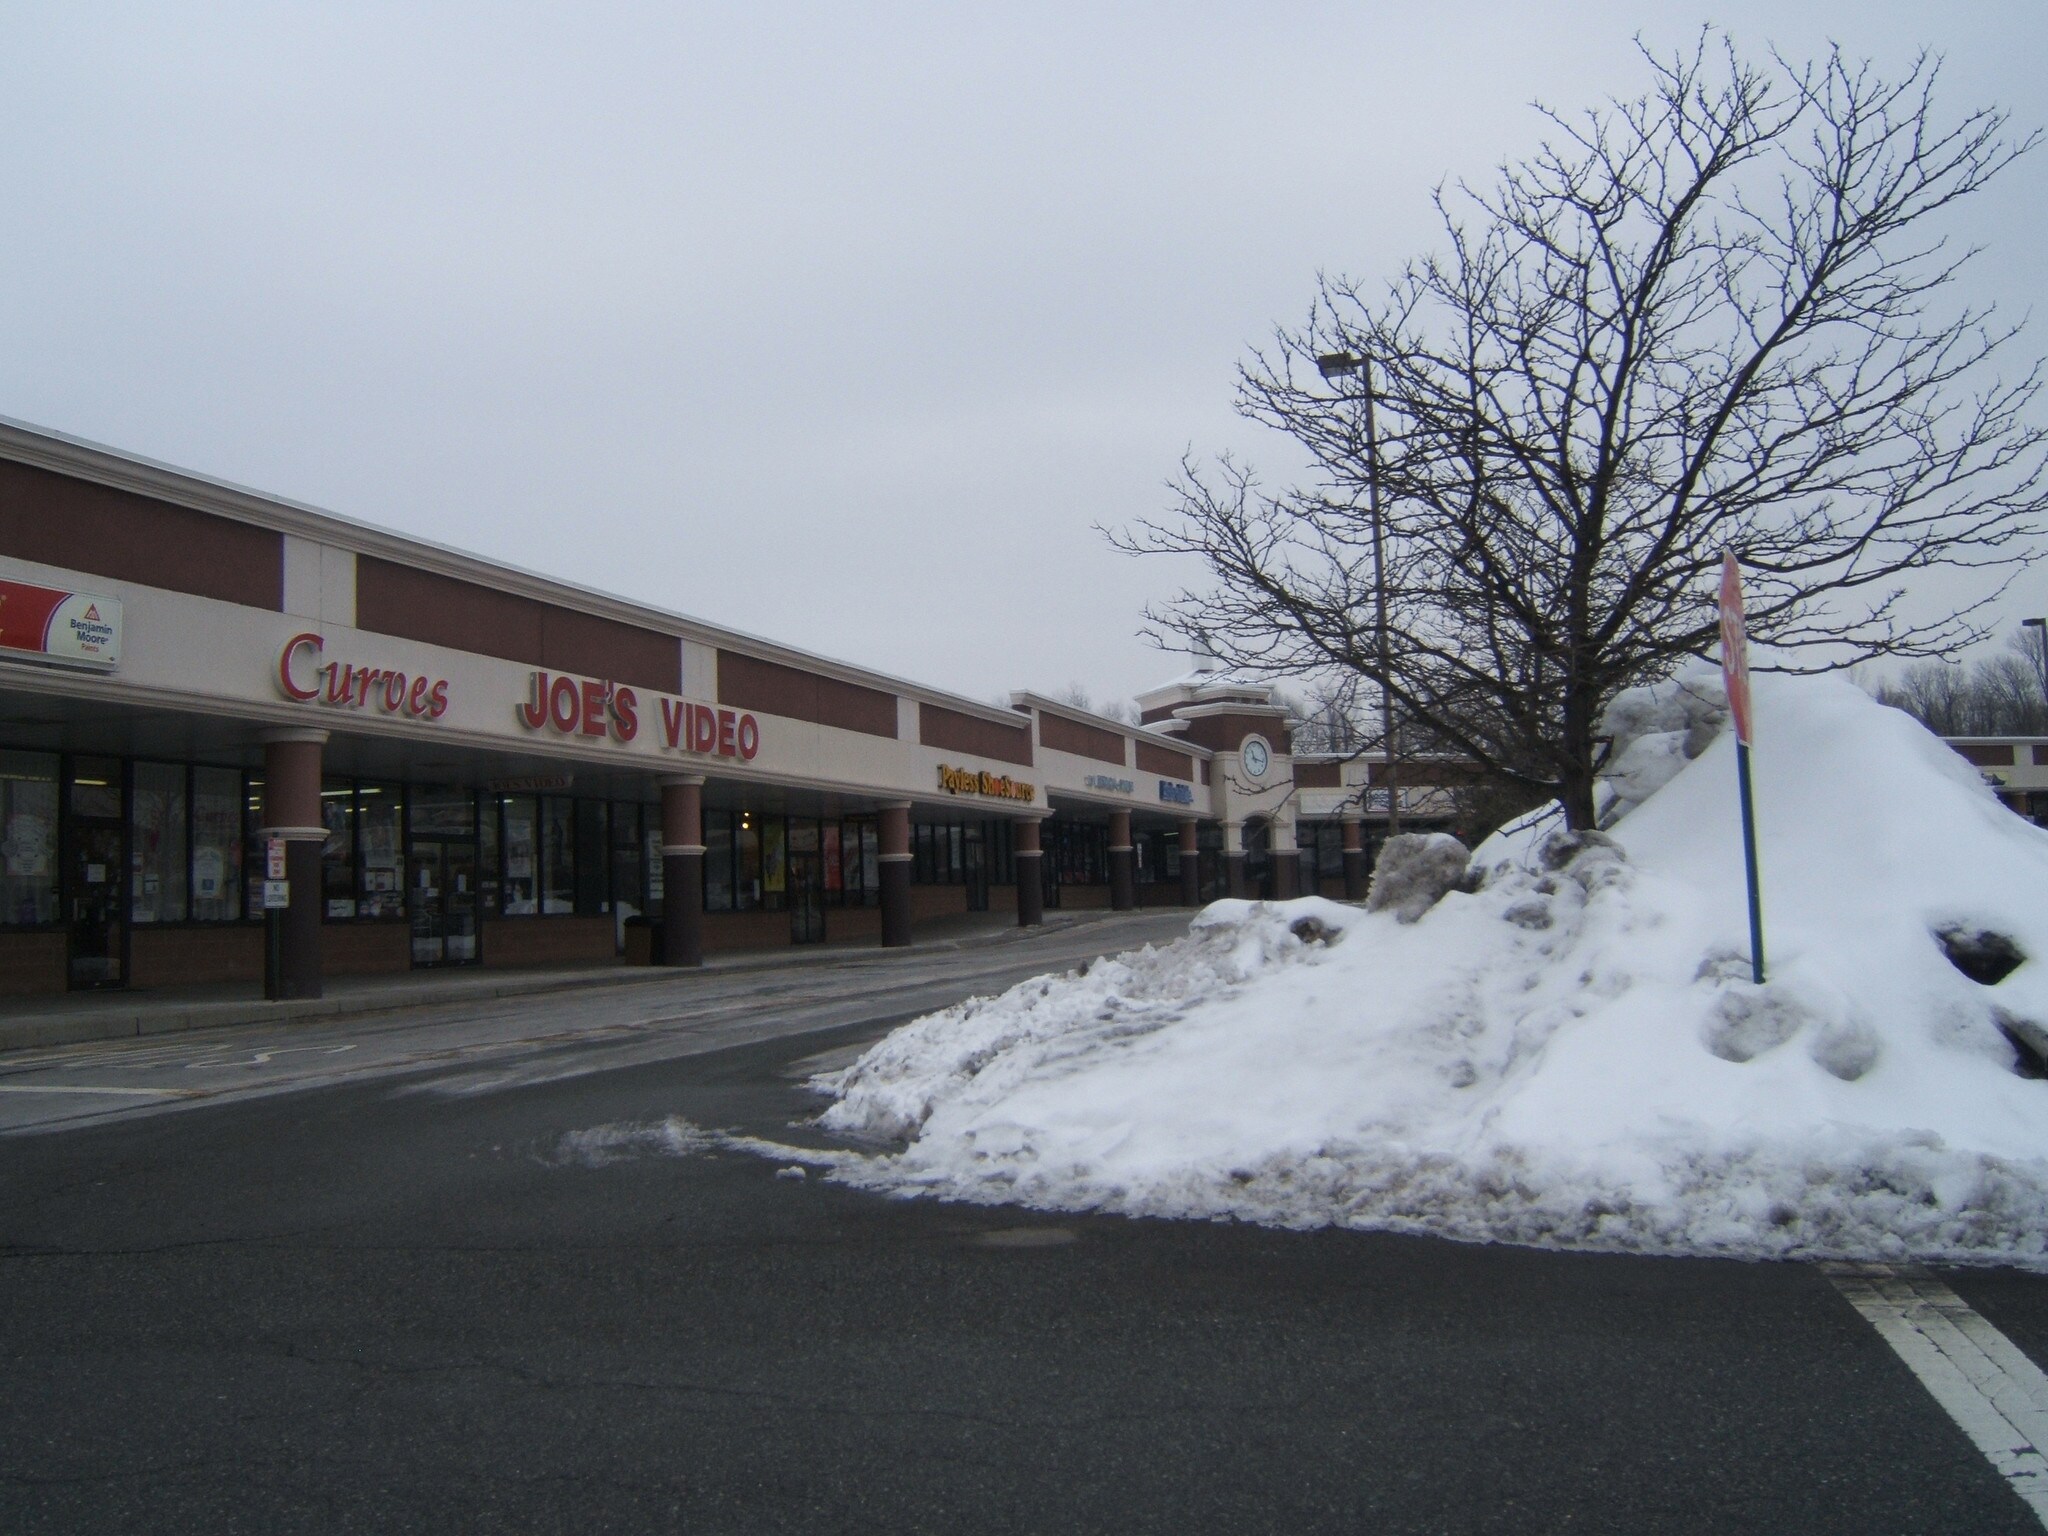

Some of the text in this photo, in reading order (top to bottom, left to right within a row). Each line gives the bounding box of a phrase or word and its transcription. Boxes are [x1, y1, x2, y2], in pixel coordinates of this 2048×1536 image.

[70, 618, 113, 635] Benjamin
[277, 632, 449, 718] Curves
[515, 671, 759, 760] JOE'S VIDEO
